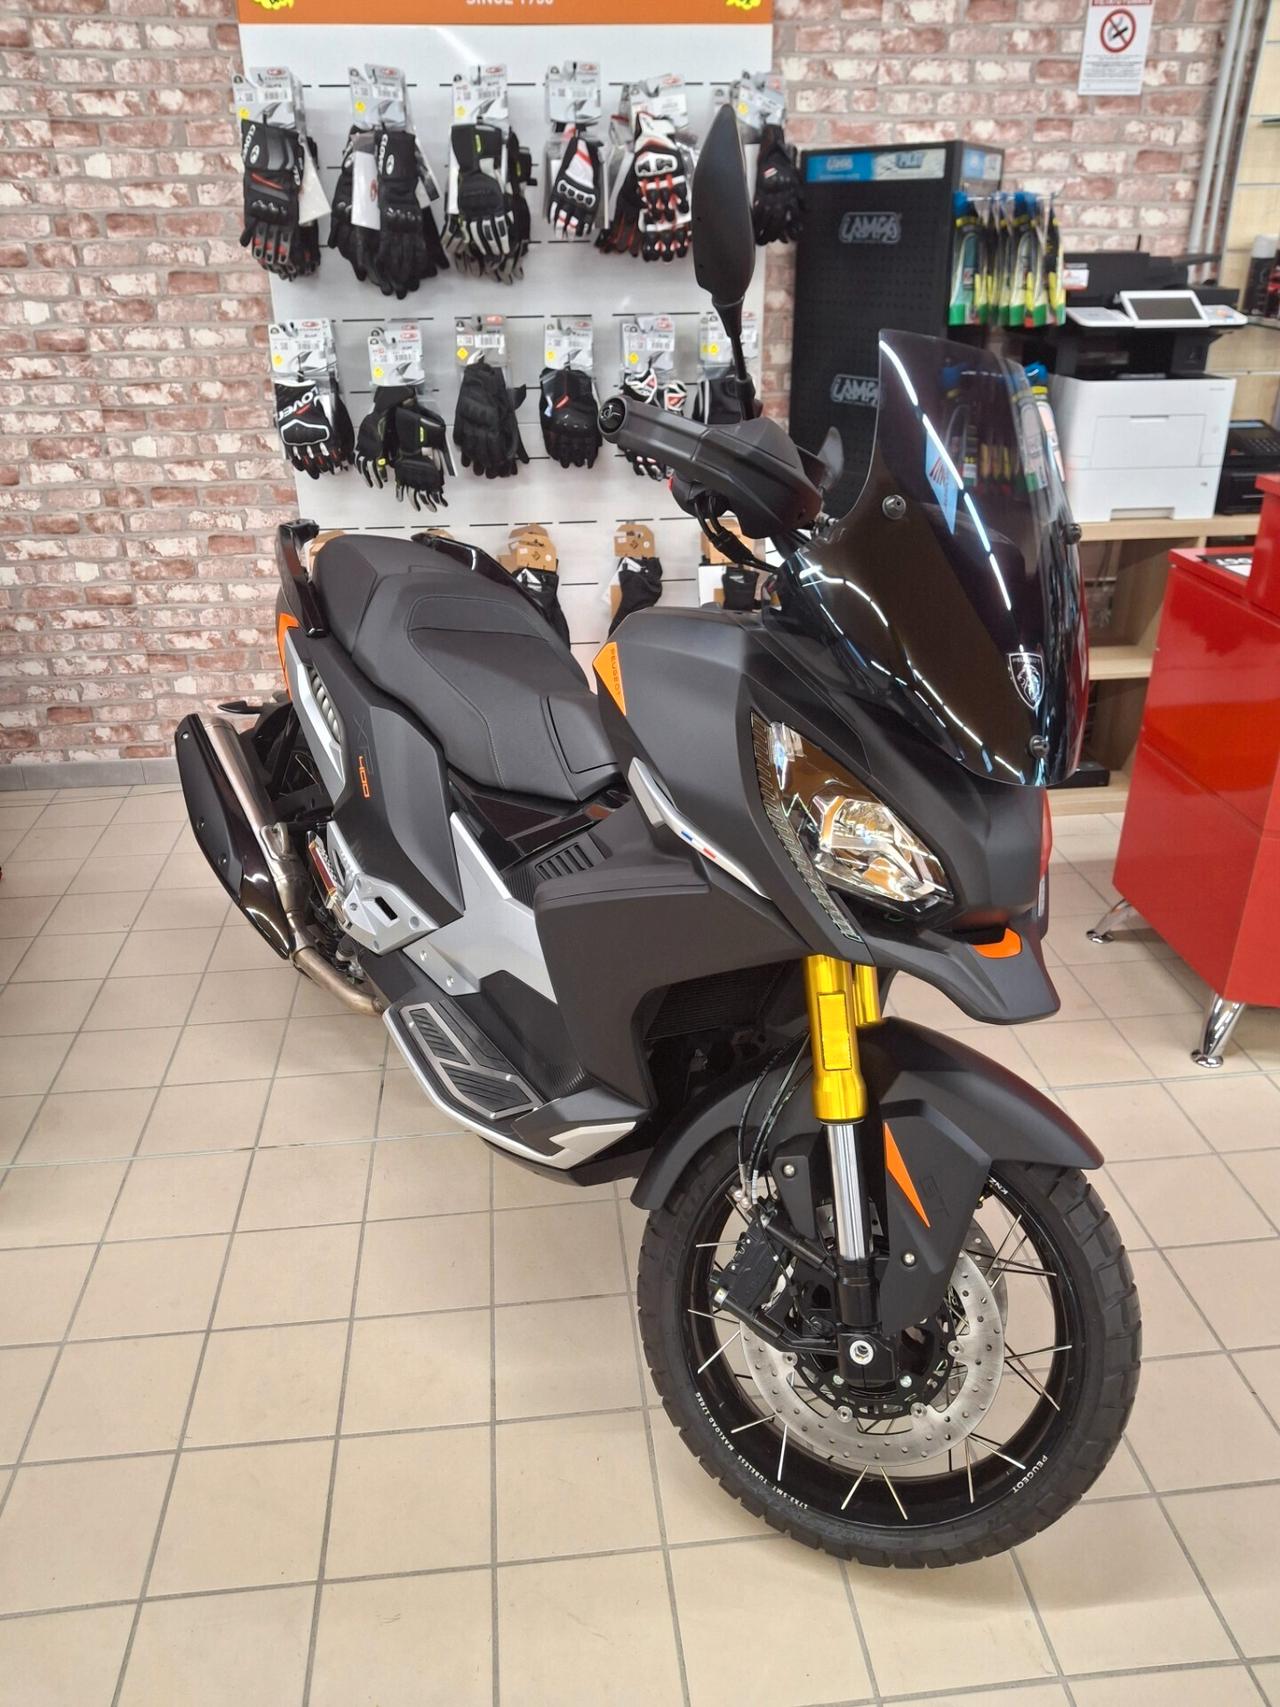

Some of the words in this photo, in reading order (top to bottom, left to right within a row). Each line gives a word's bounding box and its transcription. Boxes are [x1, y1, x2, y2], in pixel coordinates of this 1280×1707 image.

[610, 647, 621, 696] PEUGEOT
[357, 754, 371, 799] 400
[708, 1417, 734, 1451] MAXLOAD
[738, 1455, 768, 1484] TUBELESS
[1012, 1454, 1049, 1494] PEUGEOT
